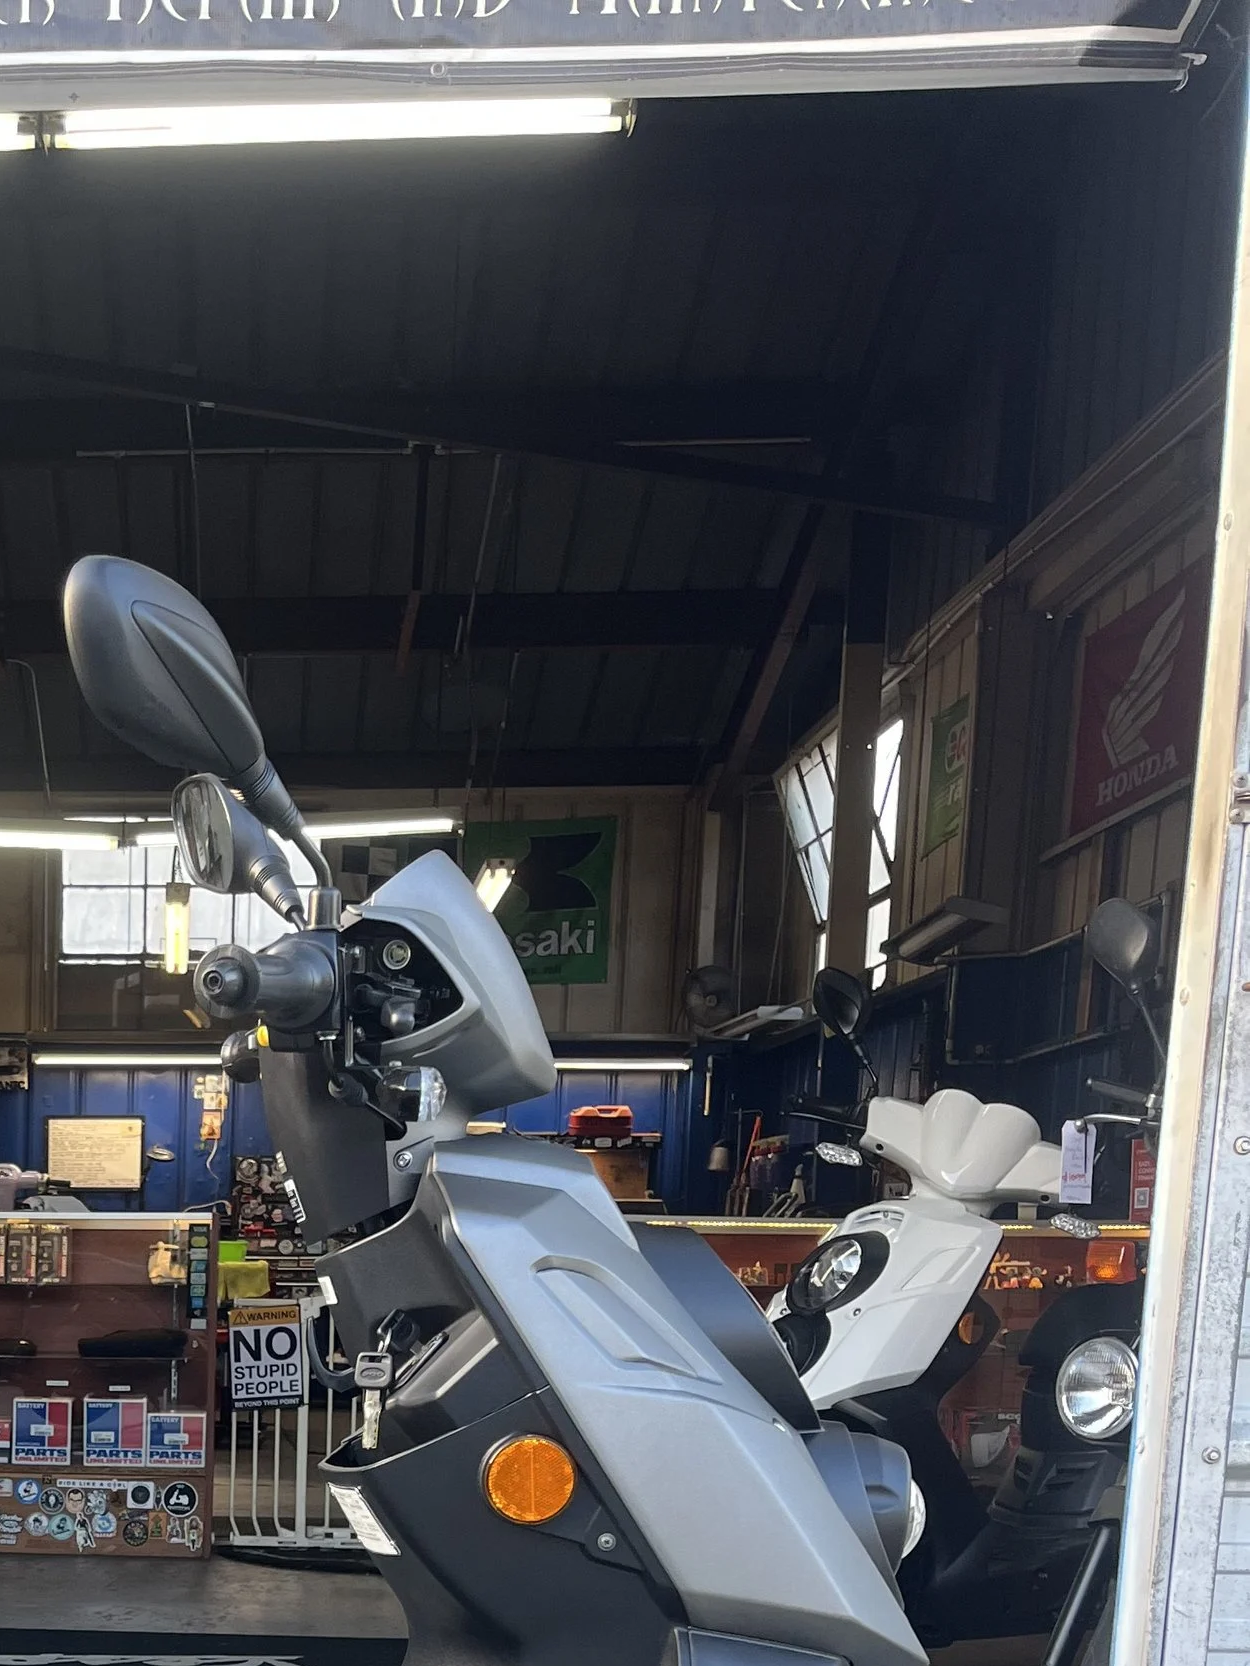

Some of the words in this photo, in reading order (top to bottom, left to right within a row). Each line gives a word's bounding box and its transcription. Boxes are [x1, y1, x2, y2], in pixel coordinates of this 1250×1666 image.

[1096, 743, 1179, 807] HONDA
[510, 920, 596, 957] saki
[247, 1310, 296, 1321] WARNING
[233, 1326, 297, 1363] NO
[234, 1363, 298, 1380] STUPID
[234, 1379, 299, 1396] PEOPLE
[235, 1400, 262, 1408] BEYOND
[15, 1448, 67, 1457] PARTS
[86, 1450, 142, 1459] PARTS
[149, 1451, 202, 1460] PARTS
